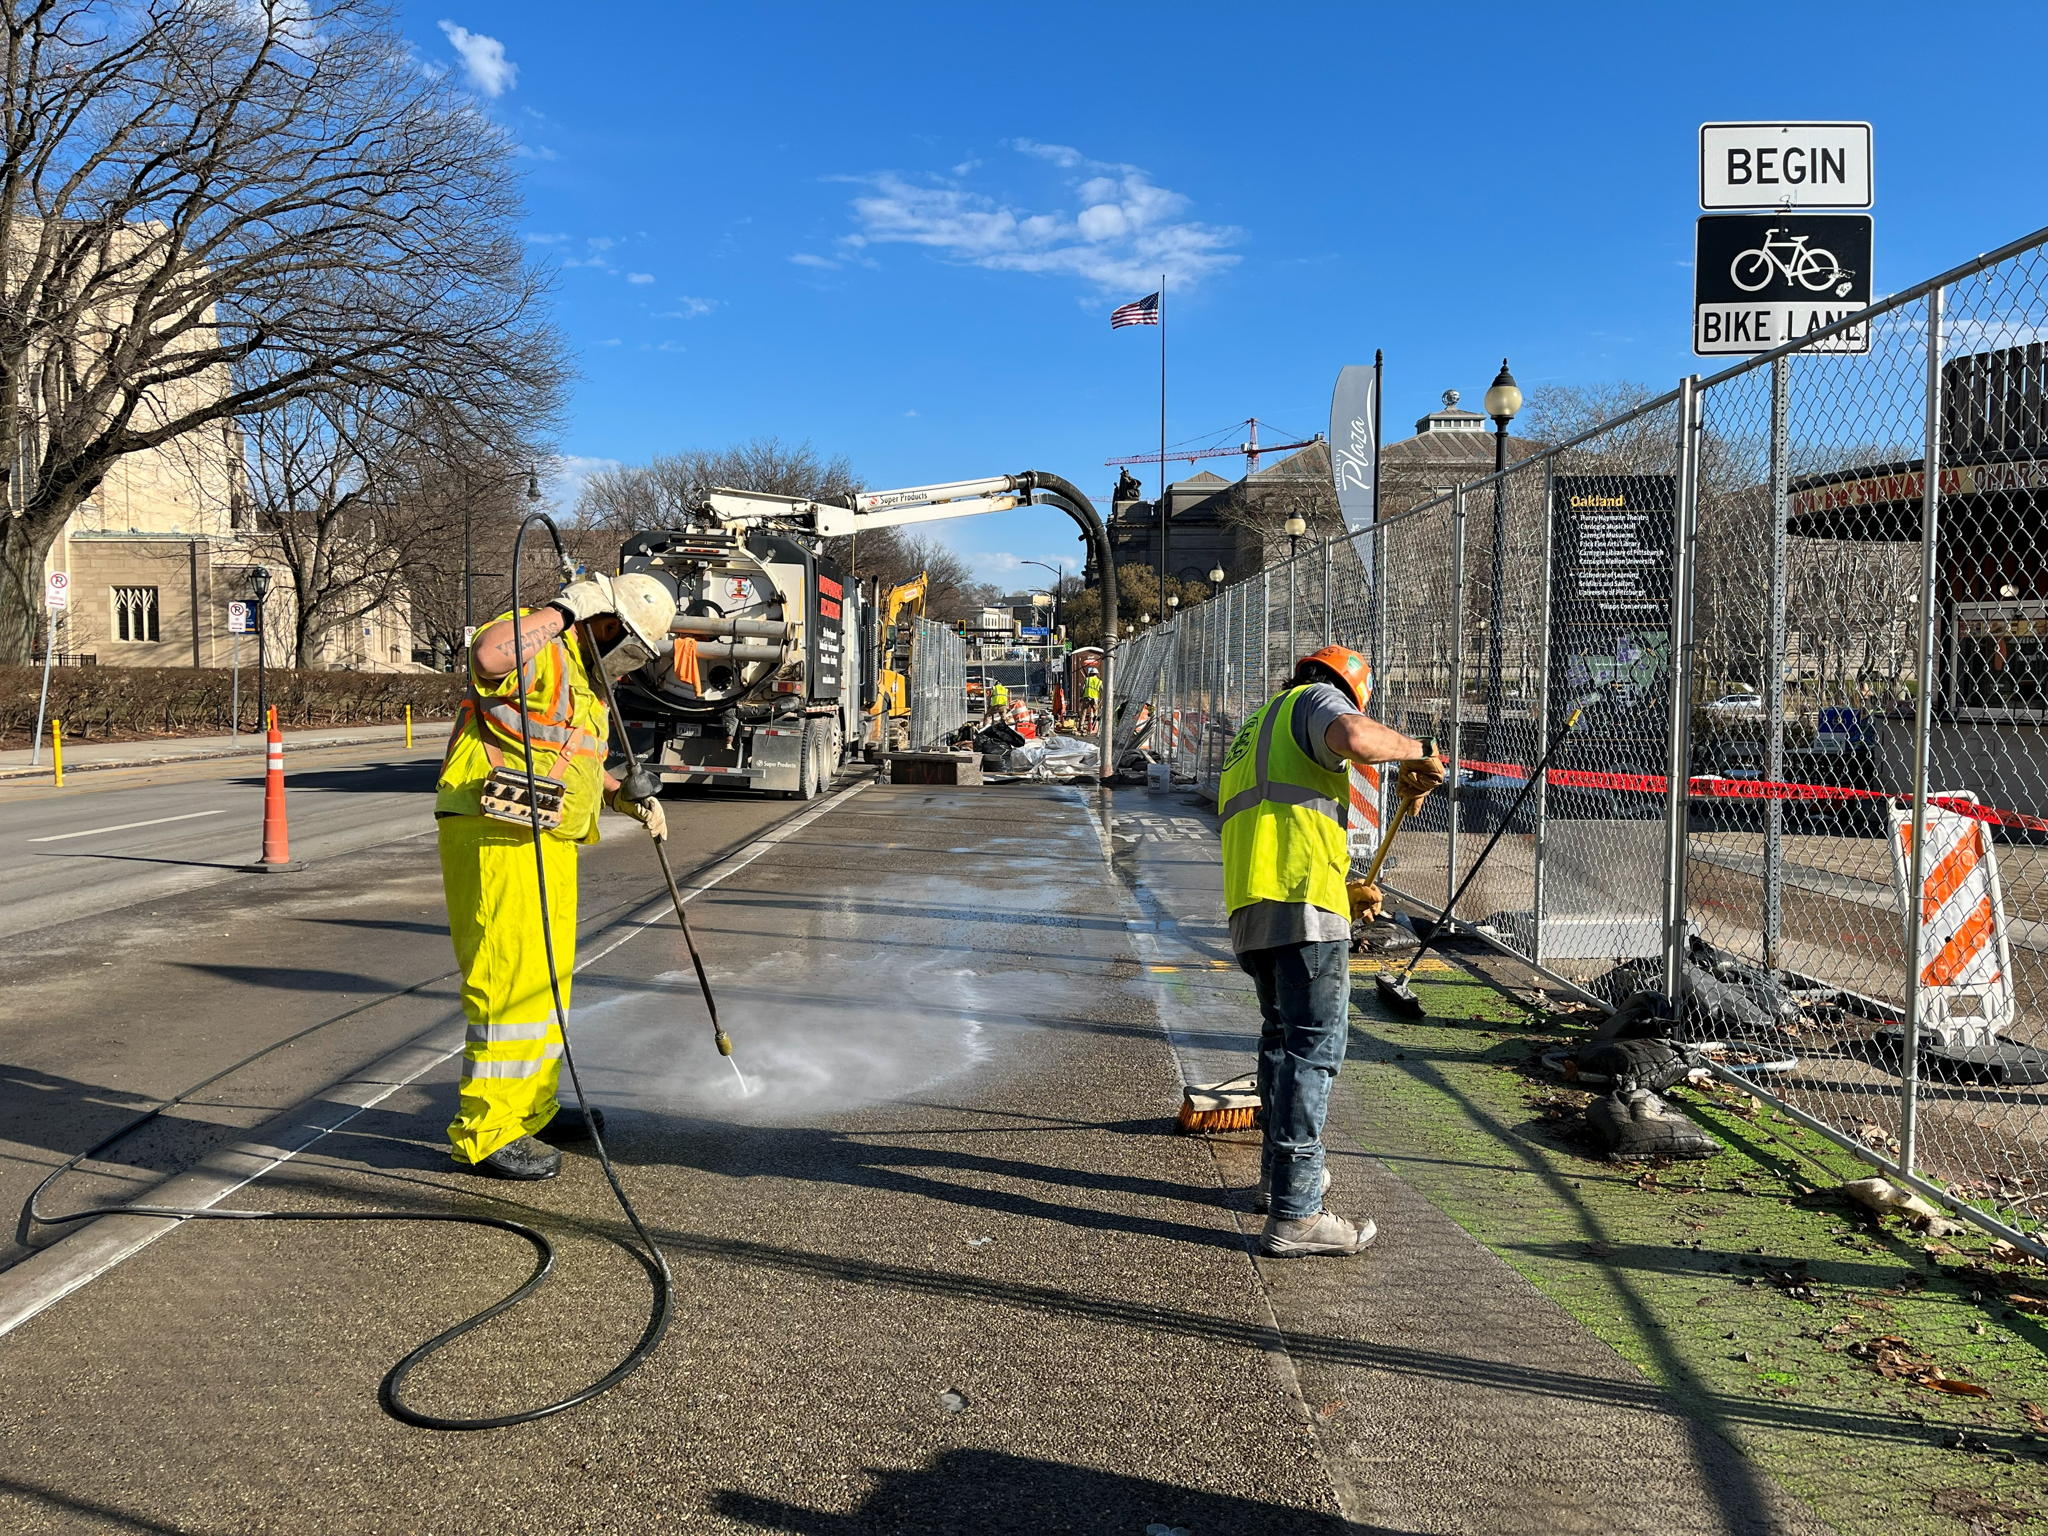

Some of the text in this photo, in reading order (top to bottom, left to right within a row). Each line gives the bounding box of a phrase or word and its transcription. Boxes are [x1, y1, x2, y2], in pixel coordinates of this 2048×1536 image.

[1728, 147, 1845, 184] BEGIN
[1704, 311, 1771, 342] BIKE
[1338, 416, 1370, 490] Plaza
[880, 492, 928, 505] Super Products
[1571, 495, 1623, 507] Oakland
